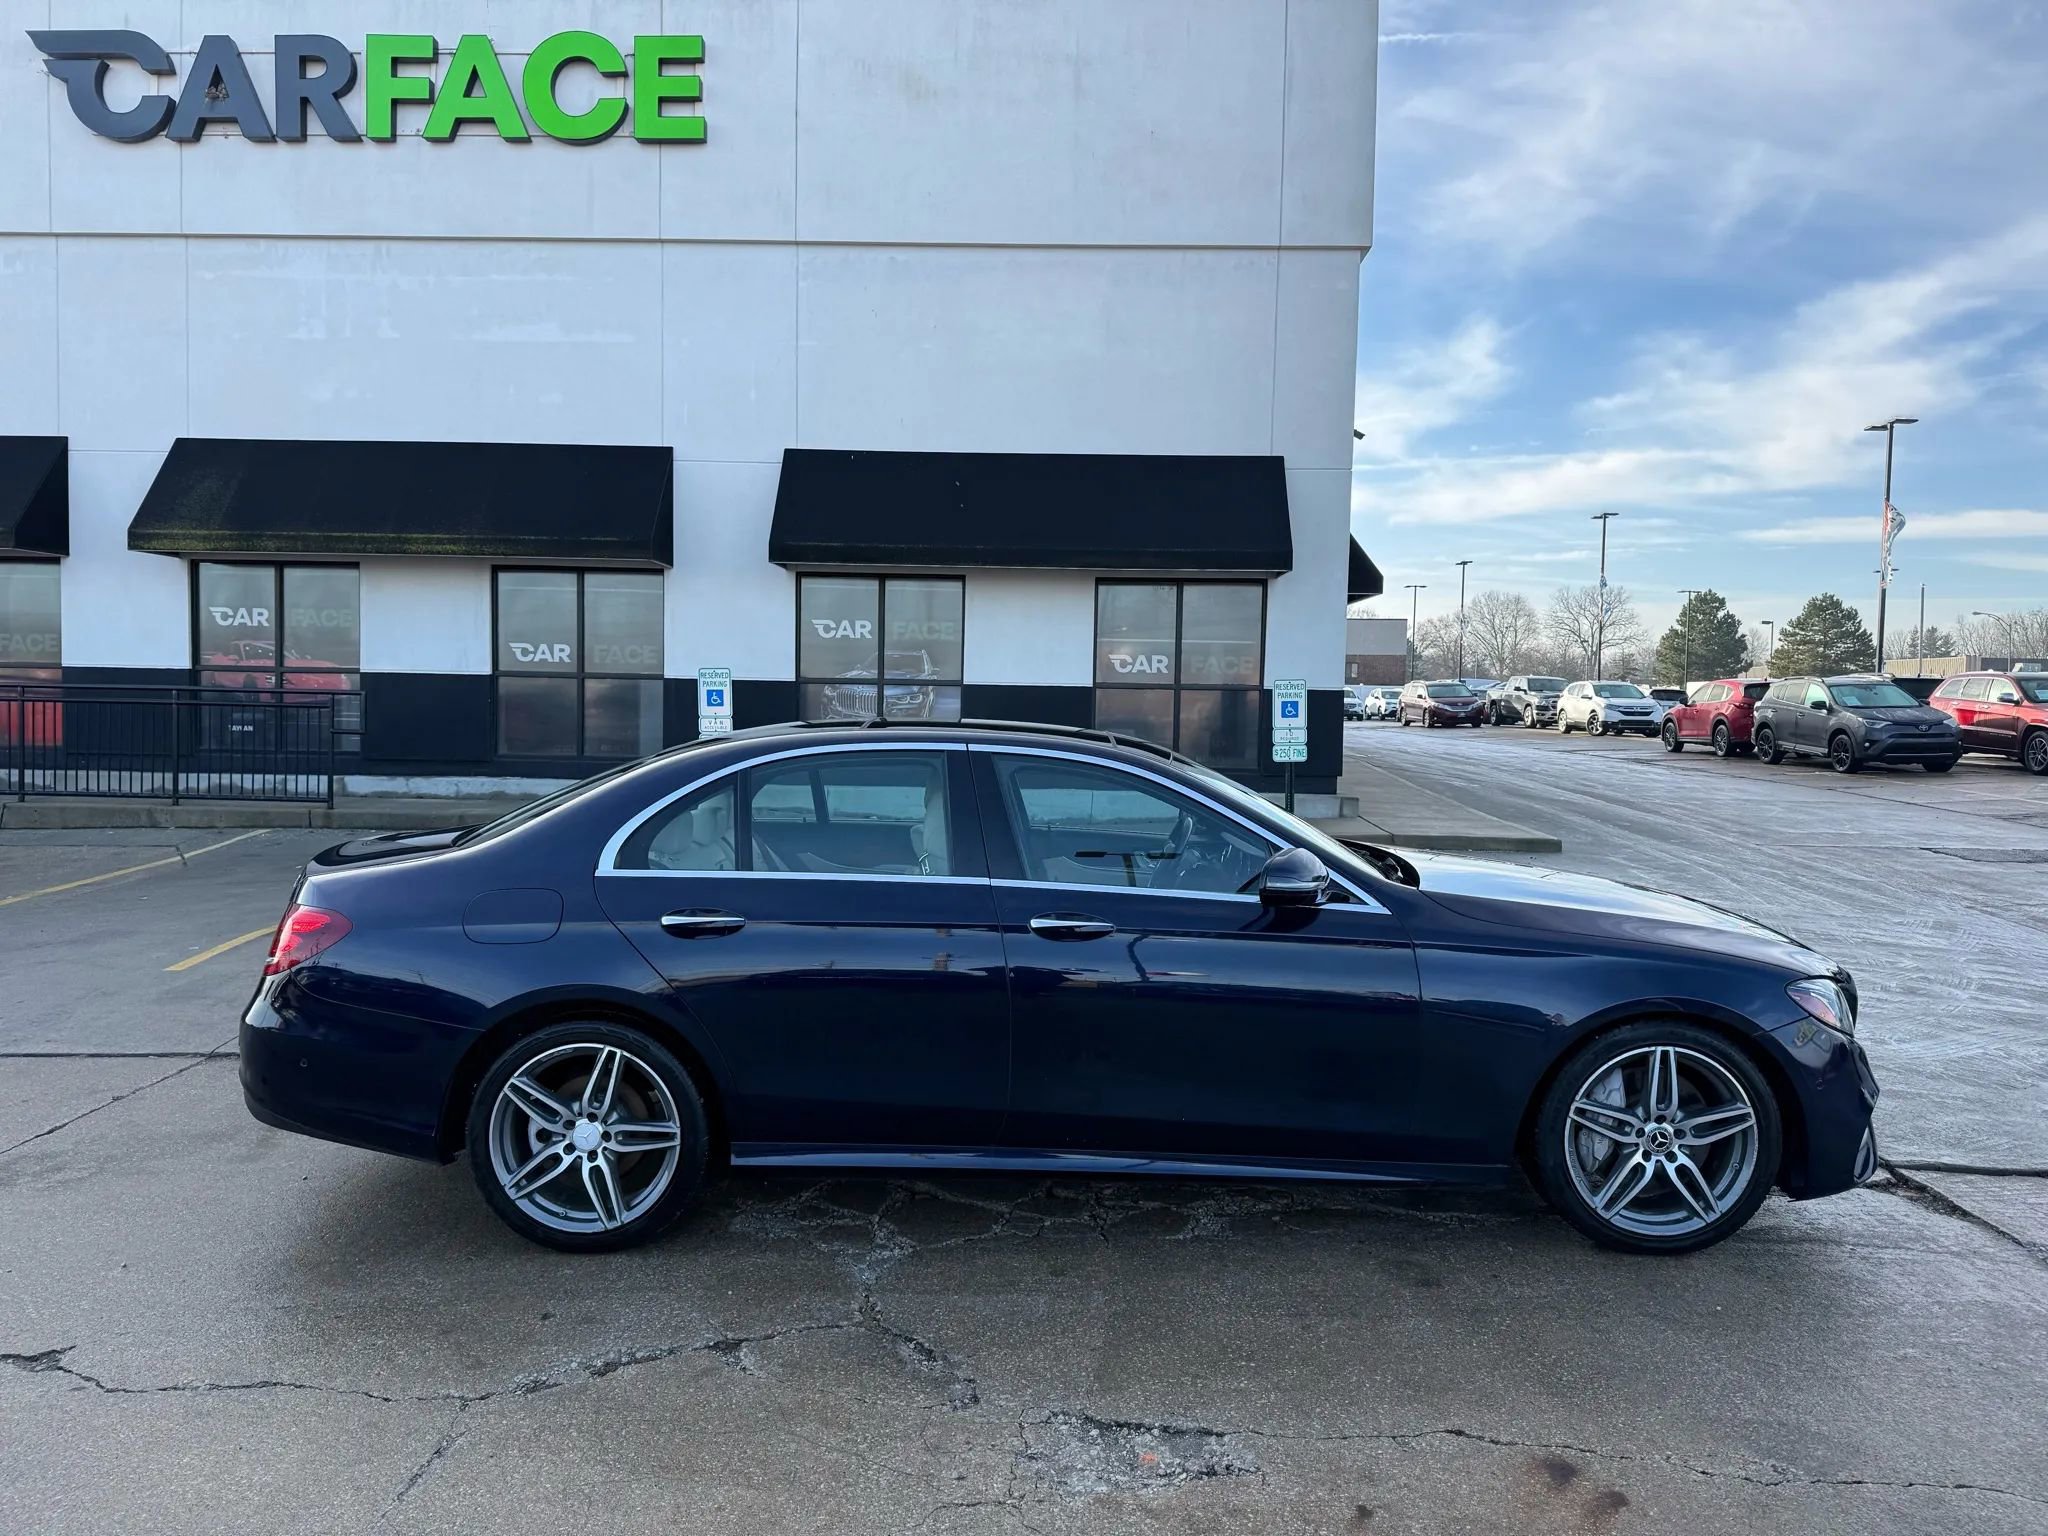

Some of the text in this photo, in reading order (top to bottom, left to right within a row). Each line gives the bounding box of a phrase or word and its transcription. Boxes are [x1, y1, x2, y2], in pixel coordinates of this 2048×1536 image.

[25, 30, 707, 143] CARFACE
[208, 606, 352, 628] CAR FACE
[811, 619, 956, 640] CAR FACE
[508, 642, 659, 665] CAR FACE
[1108, 654, 1254, 675] CAR FACE
[700, 671, 729, 679] RESERVED
[702, 680, 728, 688] PARKING
[1275, 683, 1305, 691] RESERVED
[1277, 691, 1303, 699] PARKING
[1274, 748, 1306, 758] $250 FINE
